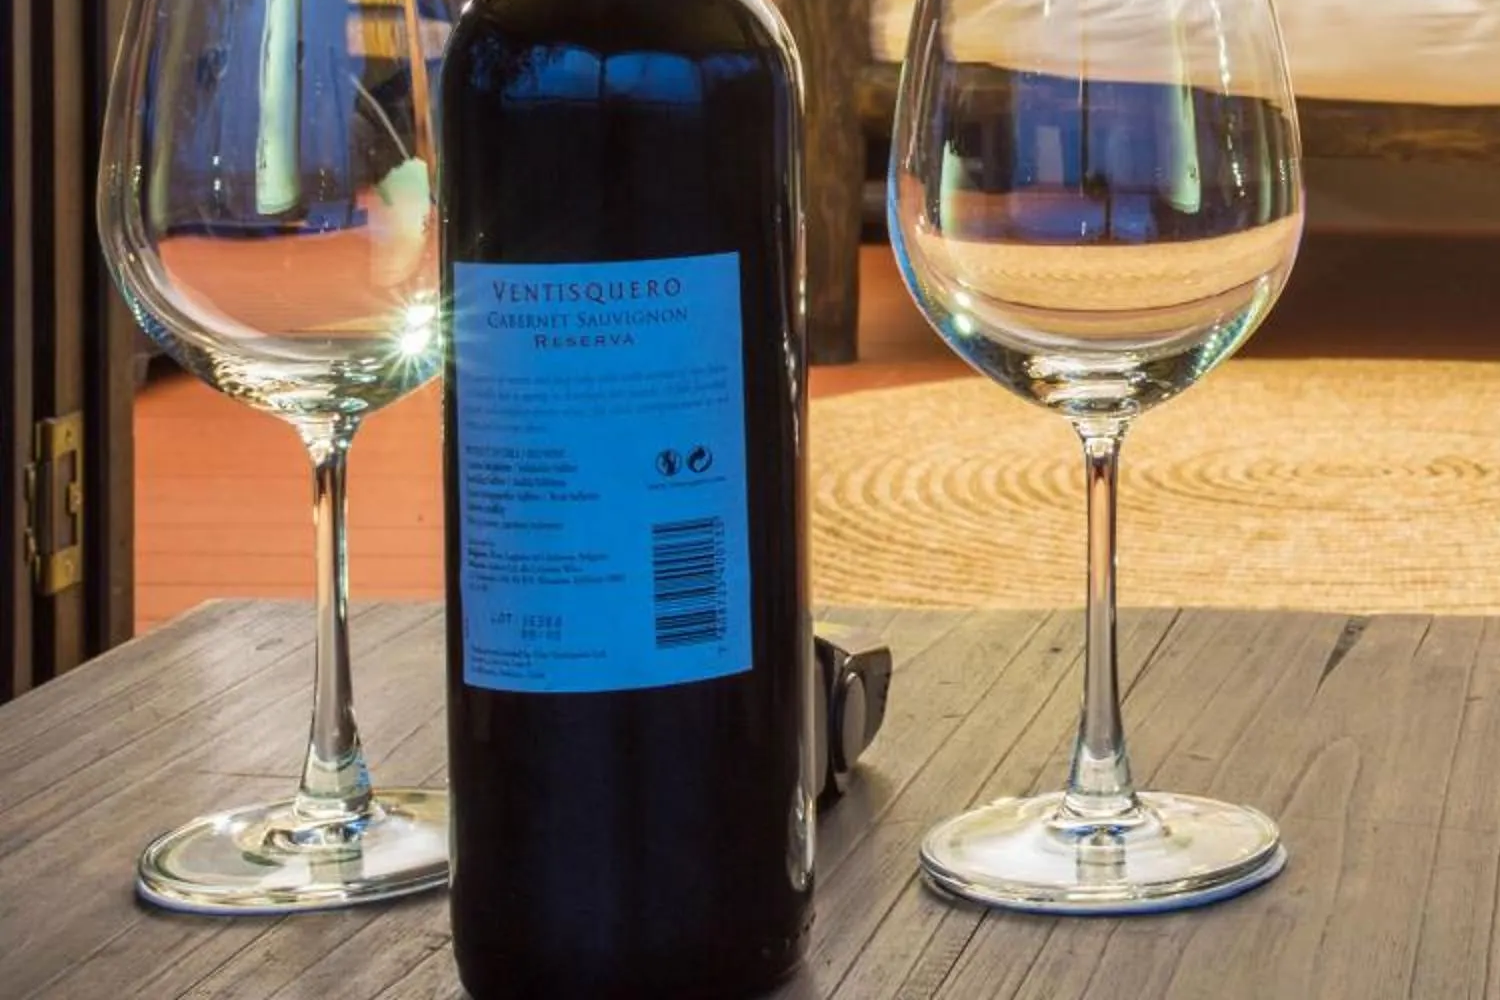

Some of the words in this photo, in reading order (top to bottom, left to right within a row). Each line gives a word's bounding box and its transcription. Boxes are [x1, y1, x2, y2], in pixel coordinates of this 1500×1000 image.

[492, 277, 682, 305] VENTISQUERO
[486, 310, 569, 330] CABERNET
[576, 306, 688, 328] SAUVIGNON
[534, 333, 636, 349] RESERVA
